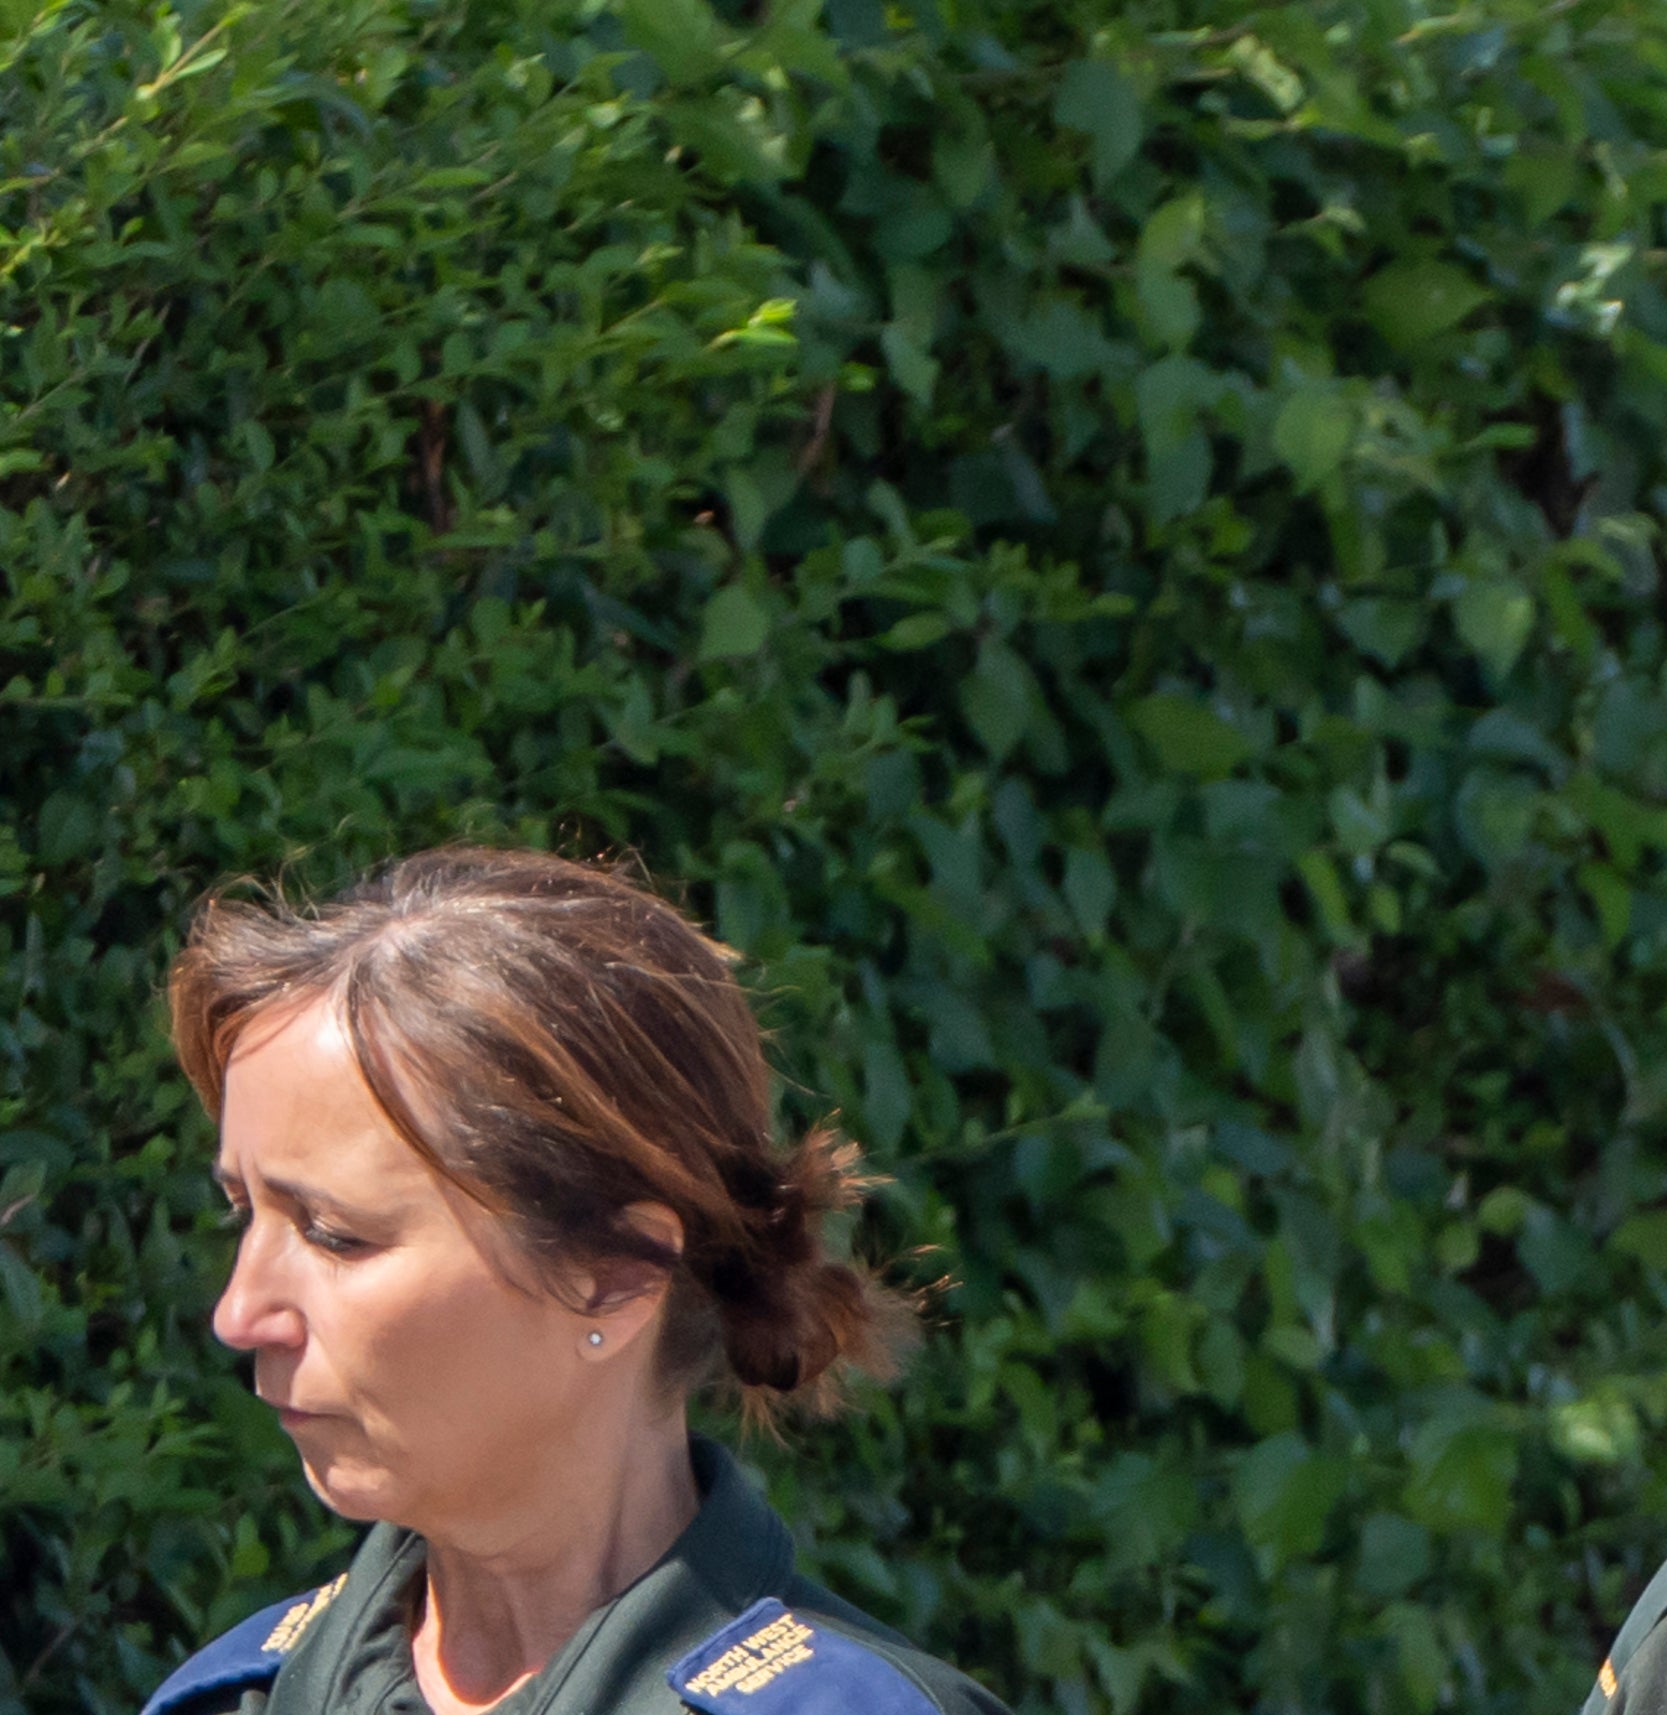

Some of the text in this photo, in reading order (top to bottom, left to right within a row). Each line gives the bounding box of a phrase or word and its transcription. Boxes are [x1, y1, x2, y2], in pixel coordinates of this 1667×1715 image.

[684, 1613, 797, 1693] NORTH WEST
[706, 1623, 814, 1697] AMBULANCE
[735, 1644, 814, 1693] SERVICE
